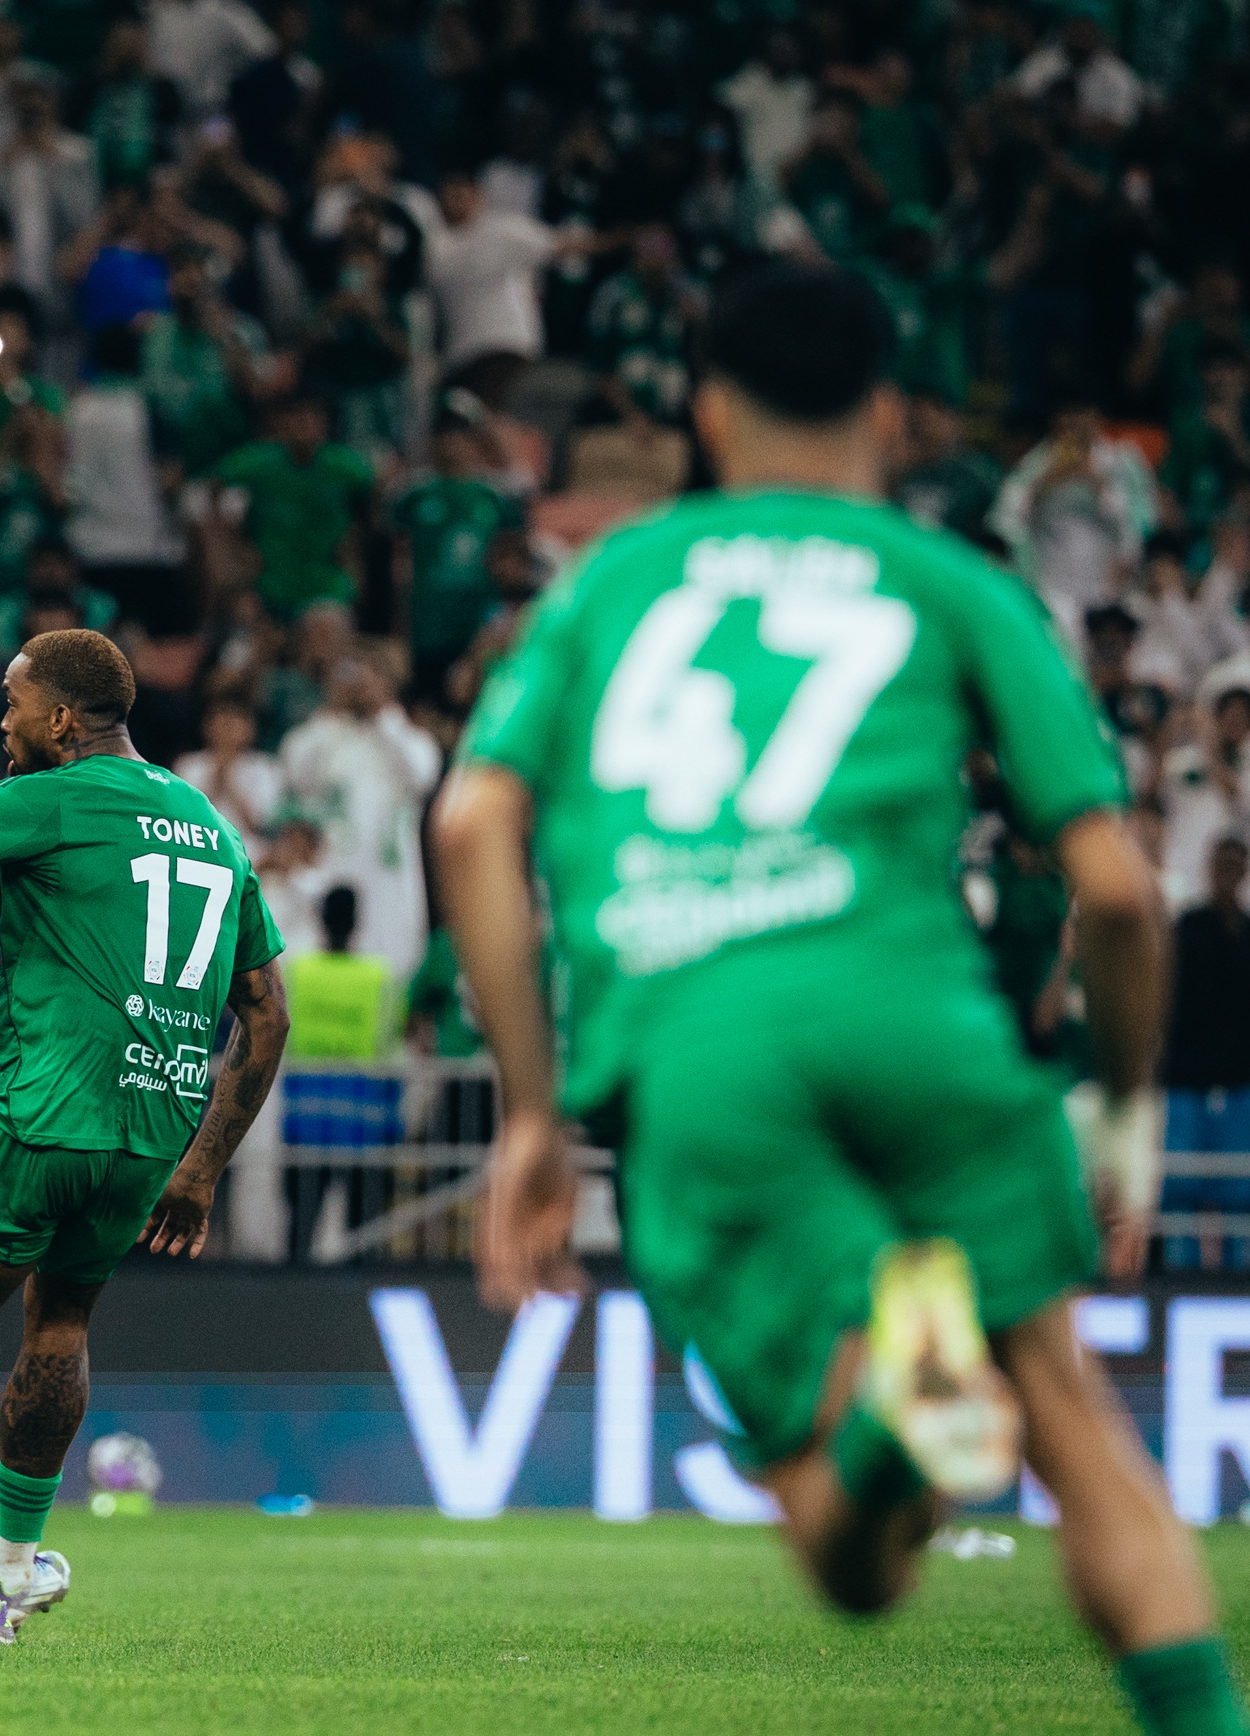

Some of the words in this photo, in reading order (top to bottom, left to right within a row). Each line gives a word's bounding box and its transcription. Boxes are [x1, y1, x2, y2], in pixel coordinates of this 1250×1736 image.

[591, 584, 918, 834] 47
[136, 816, 219, 851] TONEY
[130, 852, 234, 991] 17
[148, 998, 211, 1033] kayane
